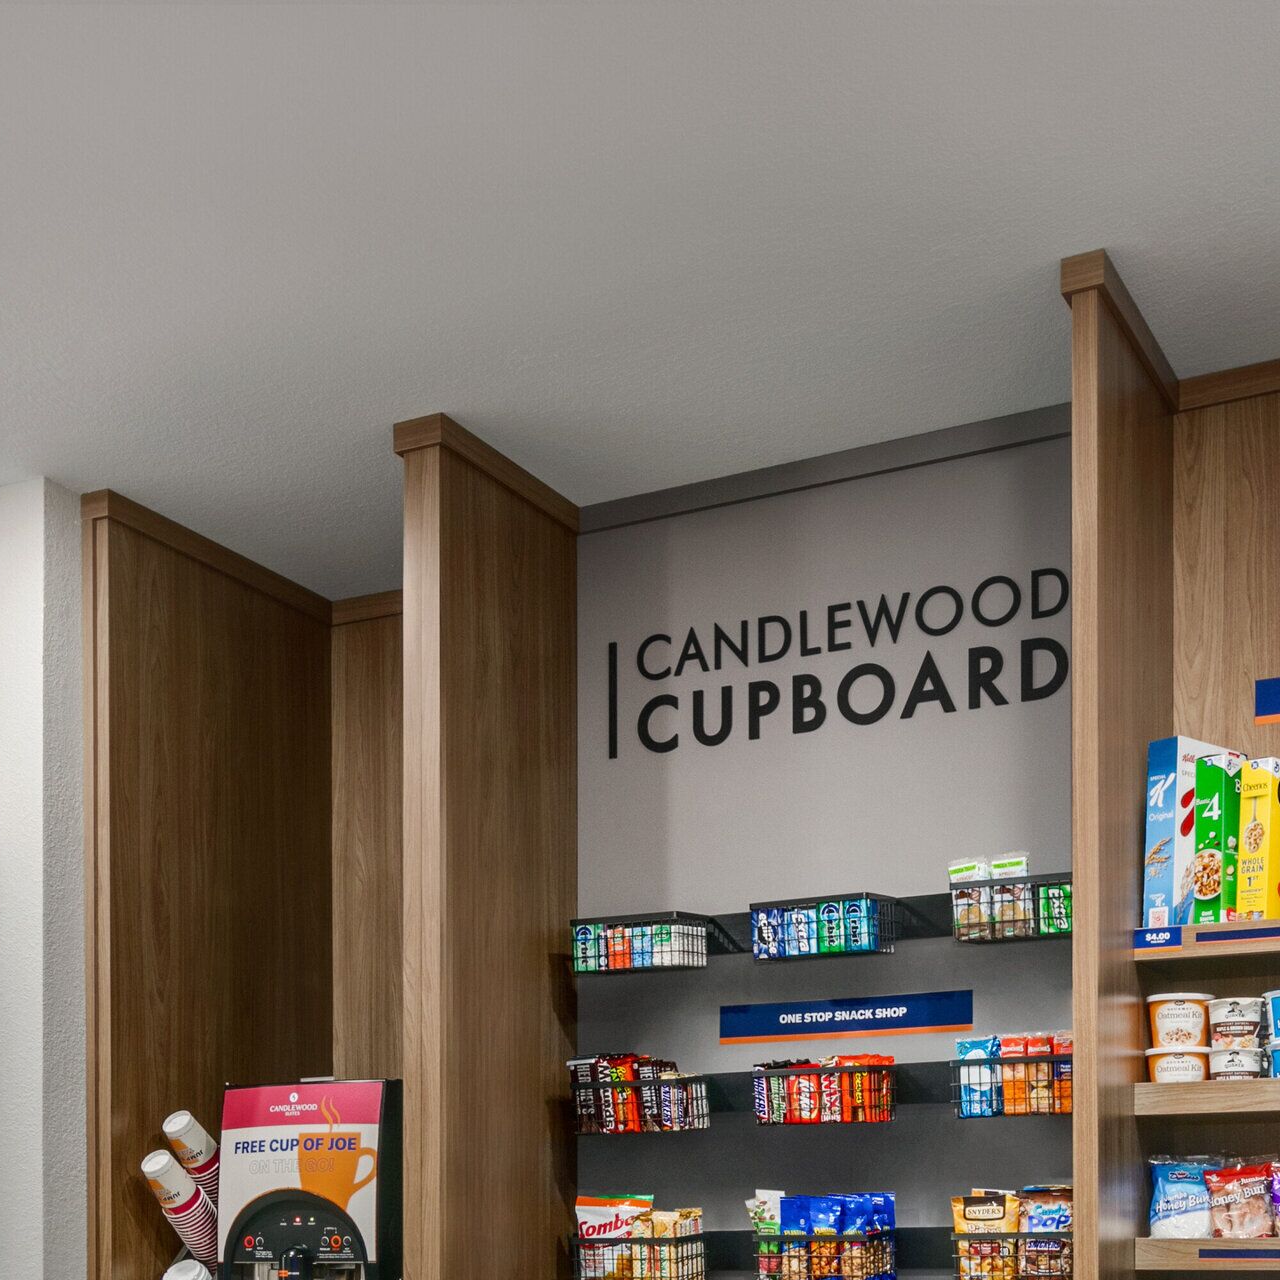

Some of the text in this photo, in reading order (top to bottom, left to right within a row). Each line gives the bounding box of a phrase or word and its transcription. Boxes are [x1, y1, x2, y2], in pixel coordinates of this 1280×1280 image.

[636, 567, 1070, 681] CANDLEWOOD
[636, 637, 1070, 754] CUPBOARD
[1145, 932, 1170, 941] $4.00
[779, 1007, 907, 1024] ONE STOP SNACK SHOP
[1191, 1010, 1202, 1018] Kit
[1191, 1064, 1202, 1072] Kit
[269, 1104, 318, 1113] CANDLEWOOD
[234, 1137, 357, 1154] FREE CUP OF JOE
[248, 1157, 335, 1175] ON THE GO!
